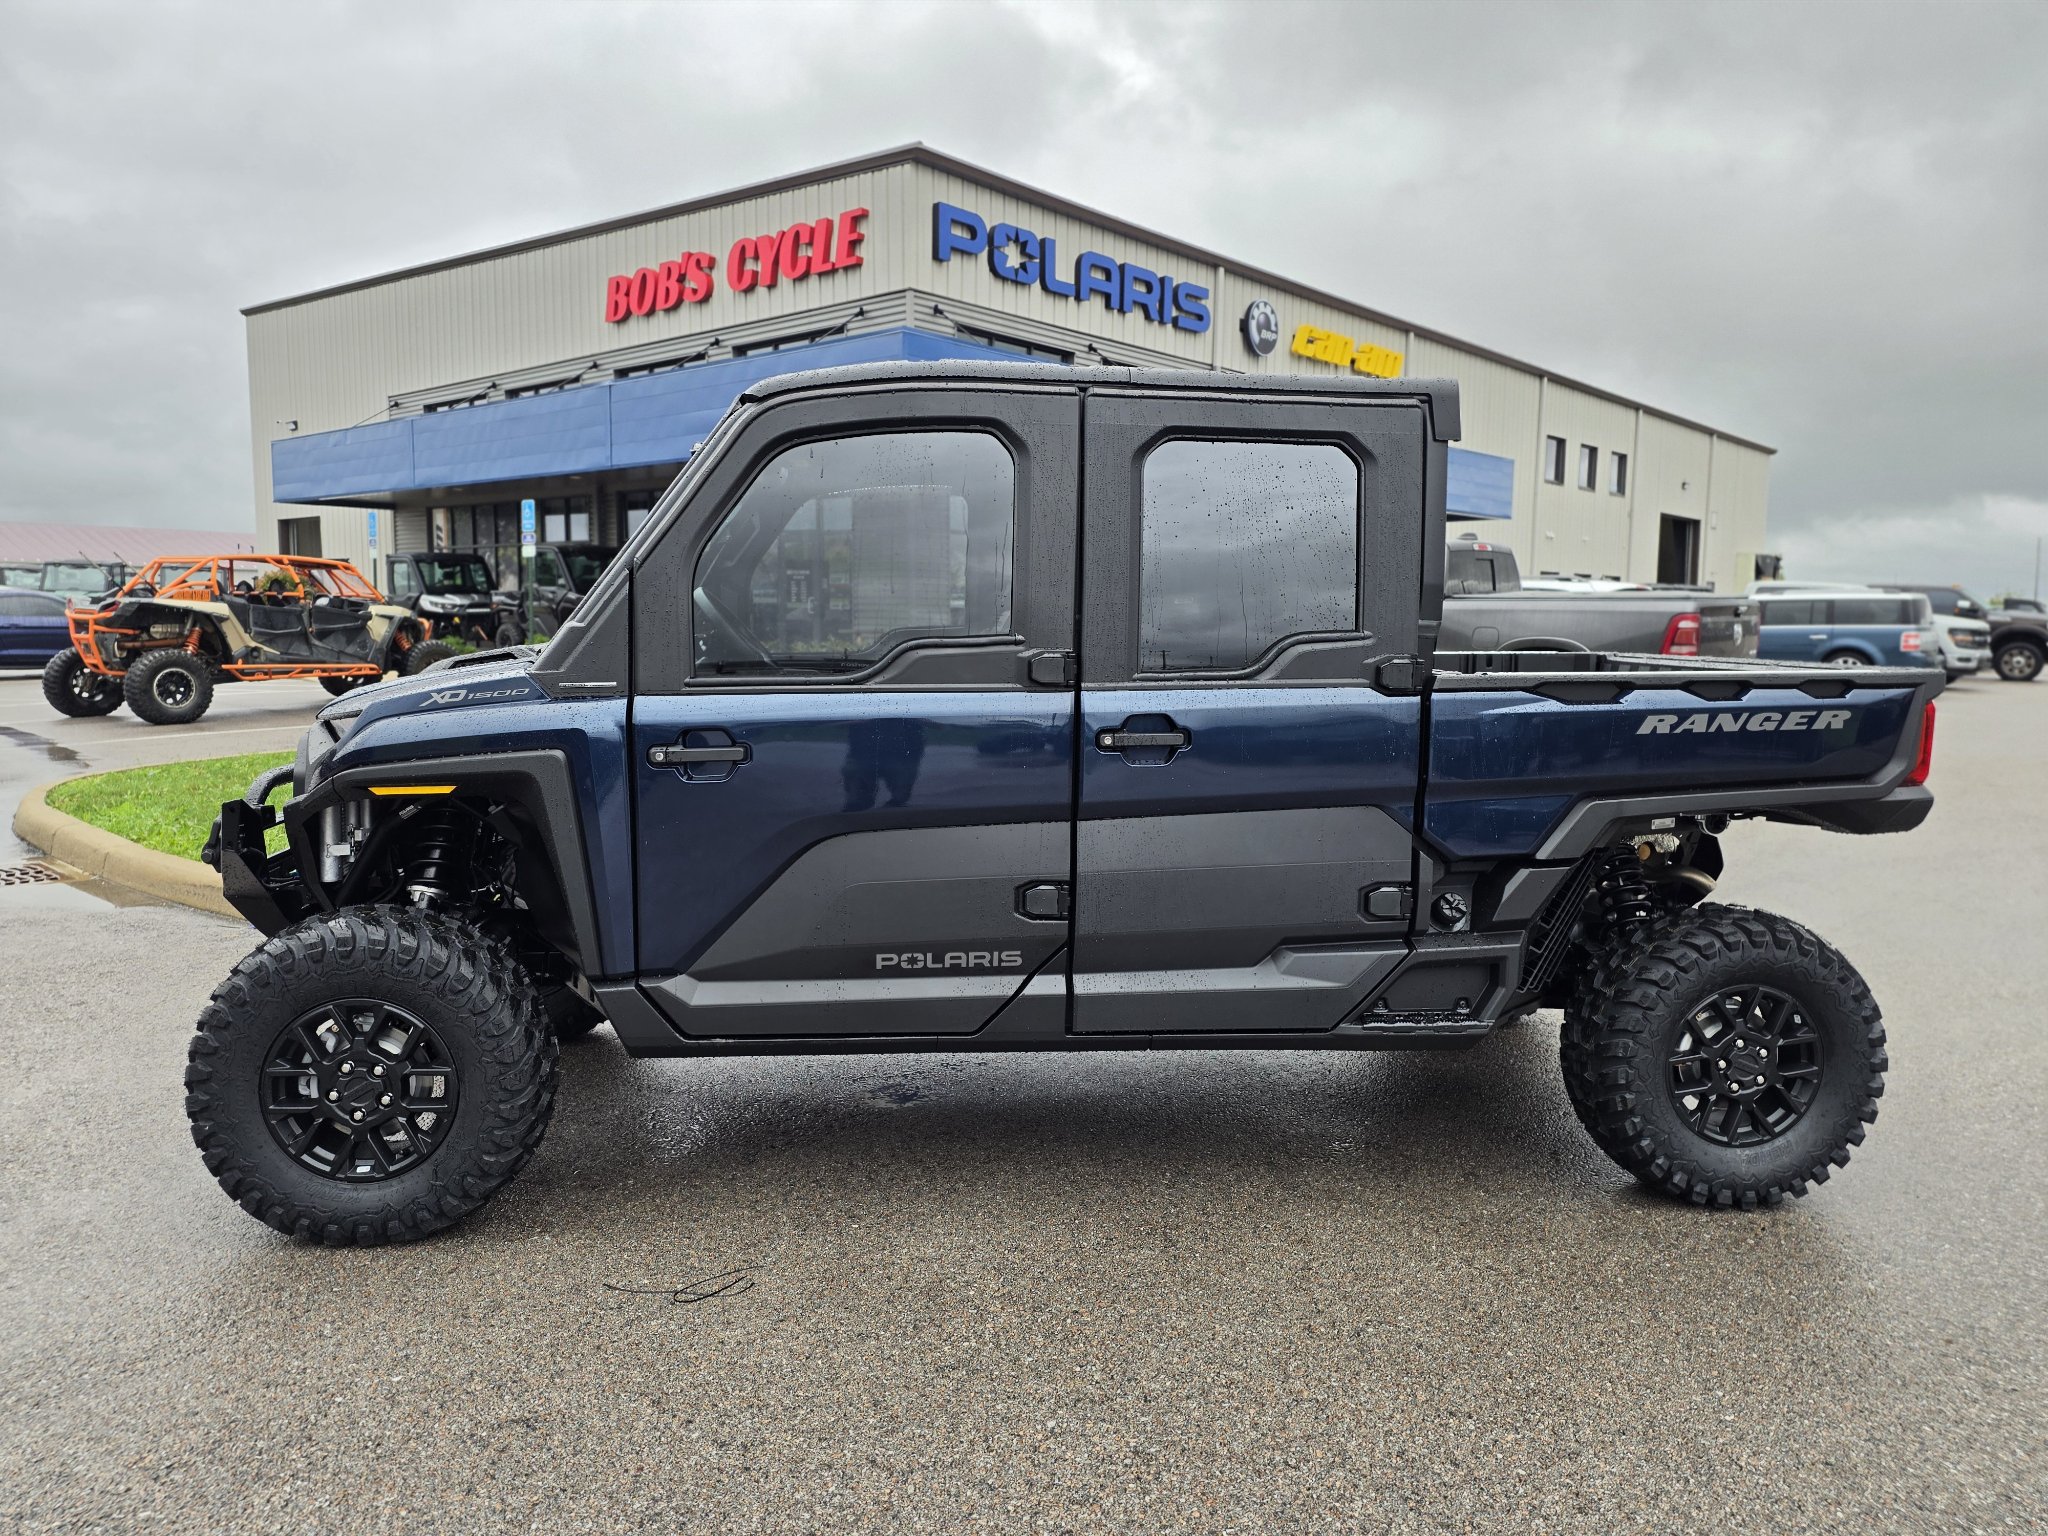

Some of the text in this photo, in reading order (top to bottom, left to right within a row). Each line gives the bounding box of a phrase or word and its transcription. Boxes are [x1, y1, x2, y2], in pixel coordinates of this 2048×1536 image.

[605, 207, 869, 323] BOB'S CYCLE
[932, 201, 1211, 333] POLARIS
[1260, 329, 1278, 342] BRP
[1636, 710, 1852, 735] RANGER
[875, 950, 1023, 970] POLARIS
